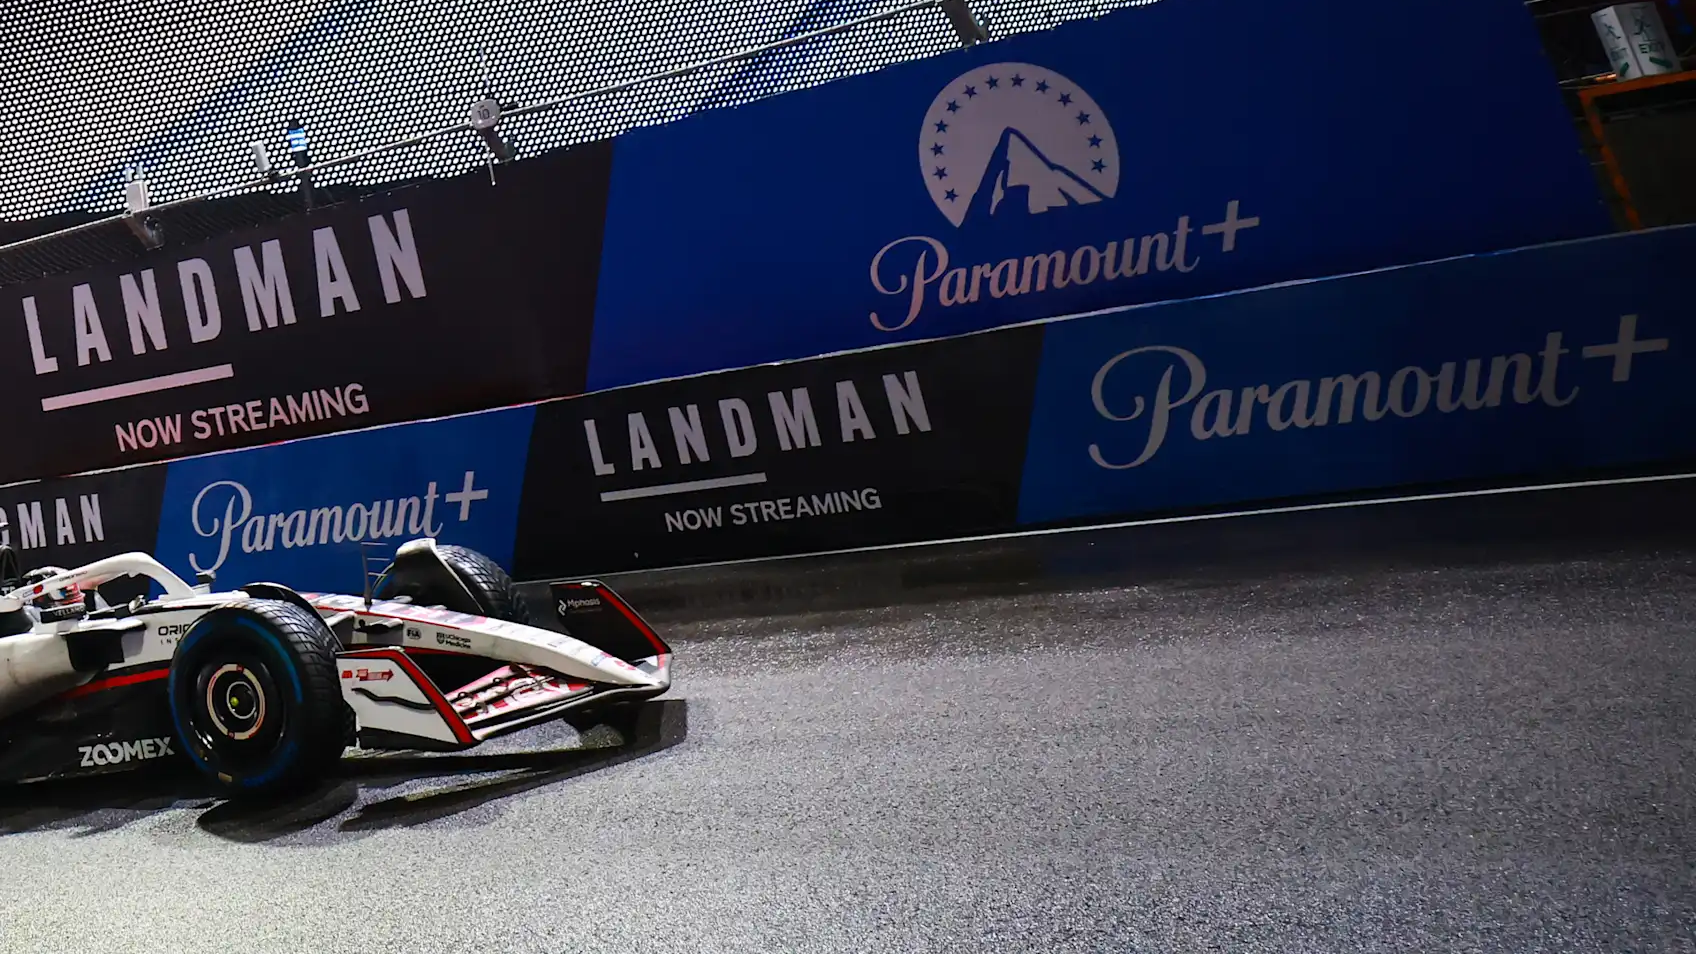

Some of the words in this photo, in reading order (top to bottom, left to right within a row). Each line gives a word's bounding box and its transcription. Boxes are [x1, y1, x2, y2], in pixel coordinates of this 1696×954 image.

[22, 208, 427, 375] LANDMAN
[869, 200, 1260, 332] Paramount+
[115, 413, 182, 452] NOW
[191, 383, 370, 439] STREAMING
[584, 371, 932, 476] LANDMAN
[1088, 315, 1669, 470] Paramount+
[188, 471, 489, 572] Paramount+
[664, 506, 722, 533] NOW
[731, 488, 883, 525] STREAMING
[78, 736, 175, 767] ZOOMEX
